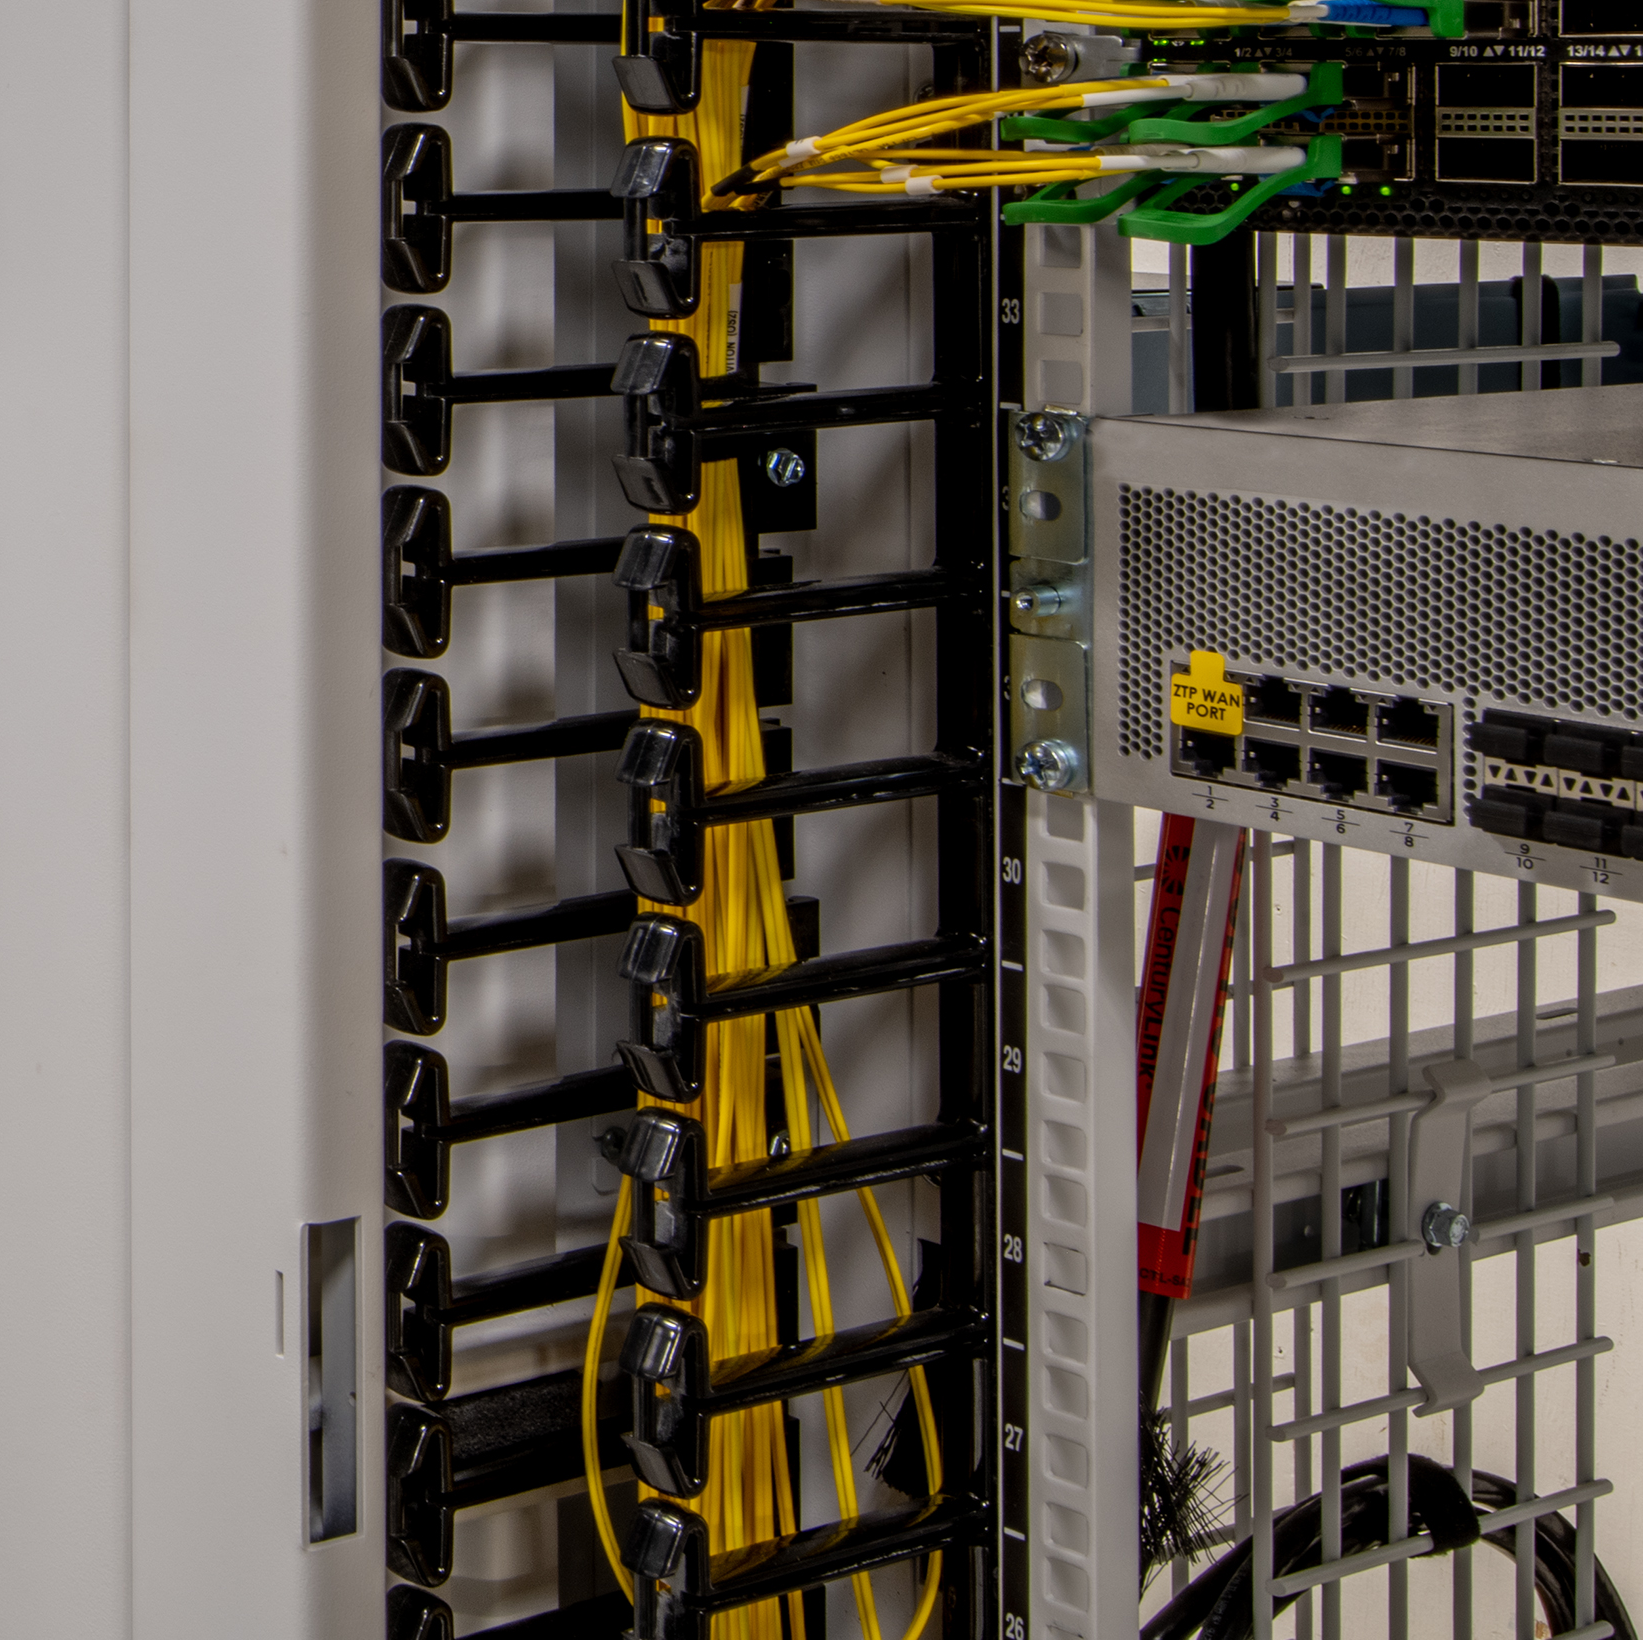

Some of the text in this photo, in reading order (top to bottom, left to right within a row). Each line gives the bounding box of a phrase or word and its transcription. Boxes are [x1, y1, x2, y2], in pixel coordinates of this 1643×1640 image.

[1234, 47, 1252, 58] 1/2
[1388, 46, 1407, 57] 7/8
[1449, 45, 1546, 58] 9/10 11/12
[1566, 45, 1605, 57] 13/14
[1002, 298, 1020, 324] 33
[1173, 684, 1240, 708] ZTP WAN
[1187, 702, 1226, 721] PORT
[1206, 799, 1215, 809] 2
[1270, 798, 1279, 808] 3
[1270, 812, 1280, 822] 4
[1336, 810, 1345, 821] 5
[1336, 824, 1346, 834] 6
[1404, 822, 1414, 833] 7
[1404, 836, 1414, 847] 8
[1520, 844, 1530, 855] 9
[1002, 856, 1021, 884] 30
[1516, 857, 1534, 870] 10
[1594, 857, 1607, 870] 11
[1593, 871, 1609, 884] 12
[1138, 906, 1181, 1078] CenturyLink
[1003, 1045, 1021, 1074] 29
[1004, 1234, 1022, 1263] 28
[1005, 1423, 1023, 1451] 27
[1006, 1612, 1024, 1640] 26
